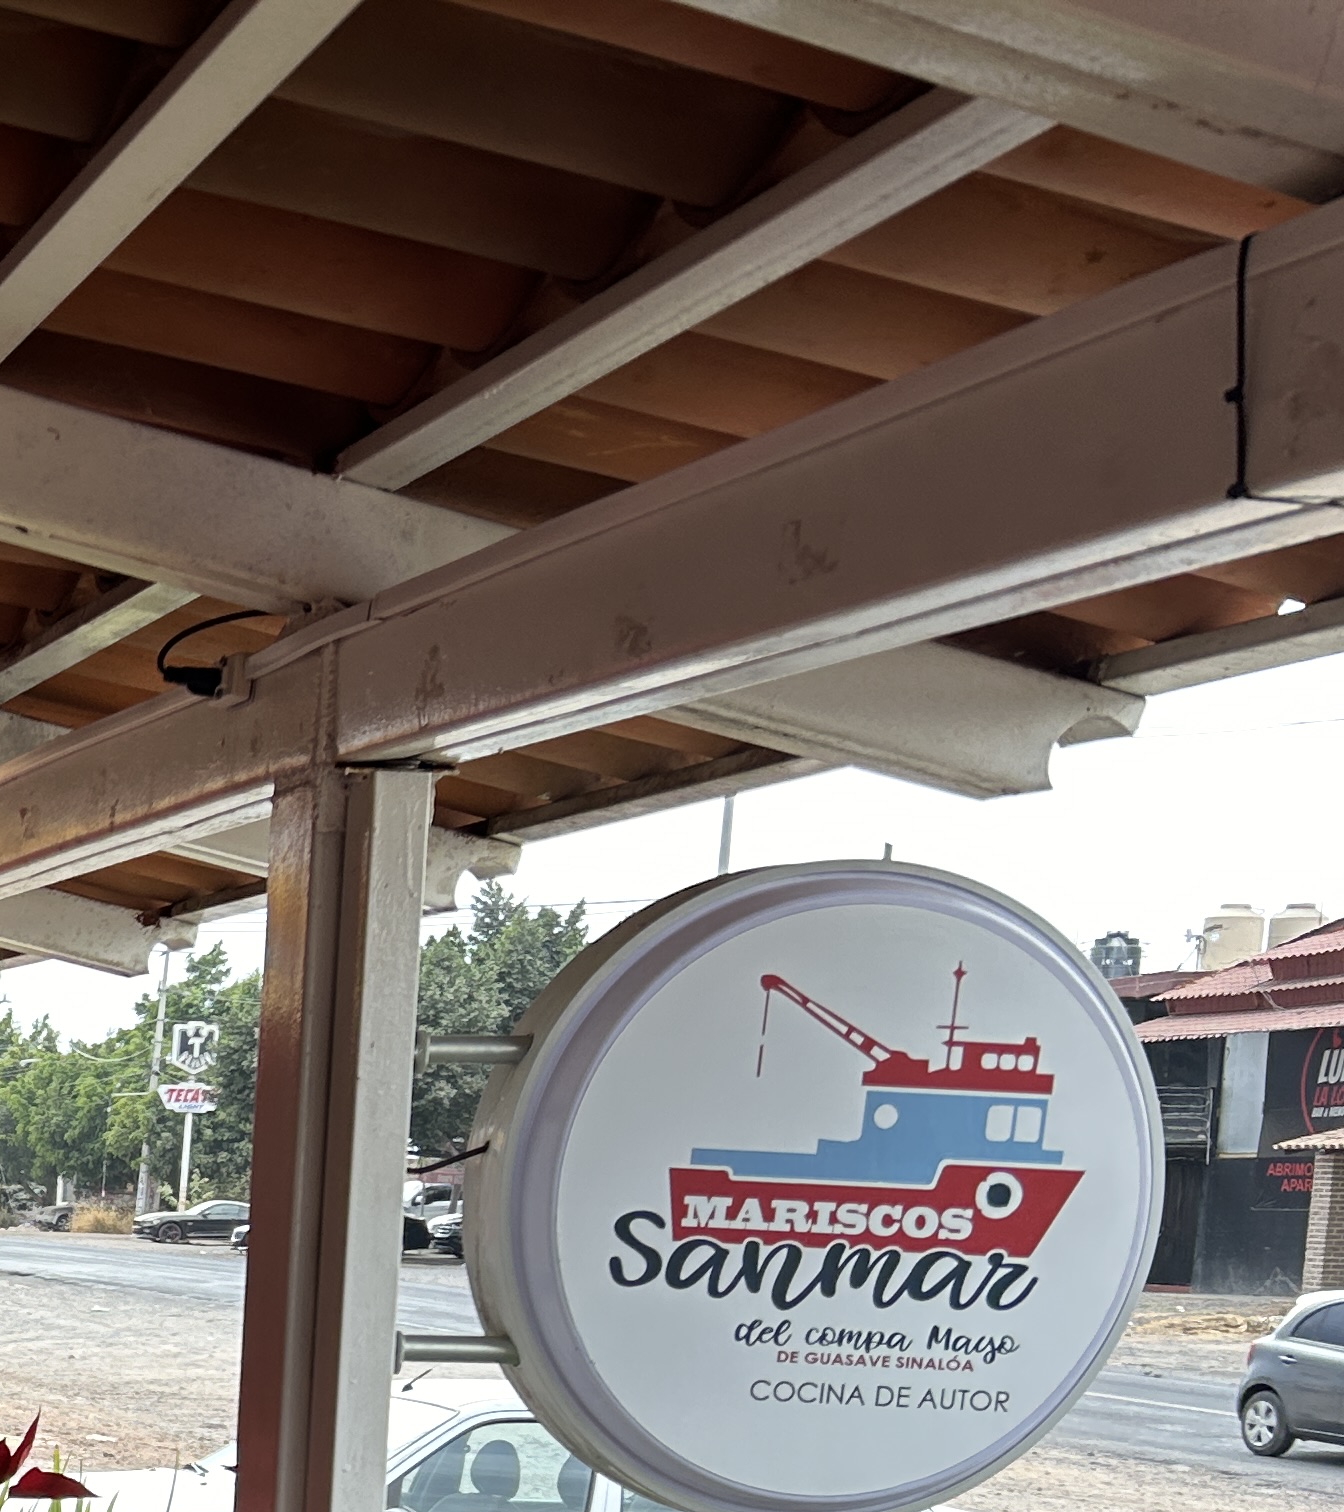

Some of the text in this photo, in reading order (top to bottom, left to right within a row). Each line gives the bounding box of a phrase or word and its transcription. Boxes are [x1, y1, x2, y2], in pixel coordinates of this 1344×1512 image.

[1317, 1048, 1344, 1085] LU
[165, 1088, 220, 1104] TECAT
[1267, 1163, 1313, 1176] ABRIMO
[1281, 1179, 1312, 1192] APAR
[681, 1195, 973, 1240] MARISCOS
[610, 1210, 1039, 1311] Sanmar
[734, 1319, 1021, 1364] del compa Mayo
[776, 1350, 974, 1373] DE GUASAVE SINALÓA
[749, 1379, 1010, 1413] COCINA DE AUTOR
